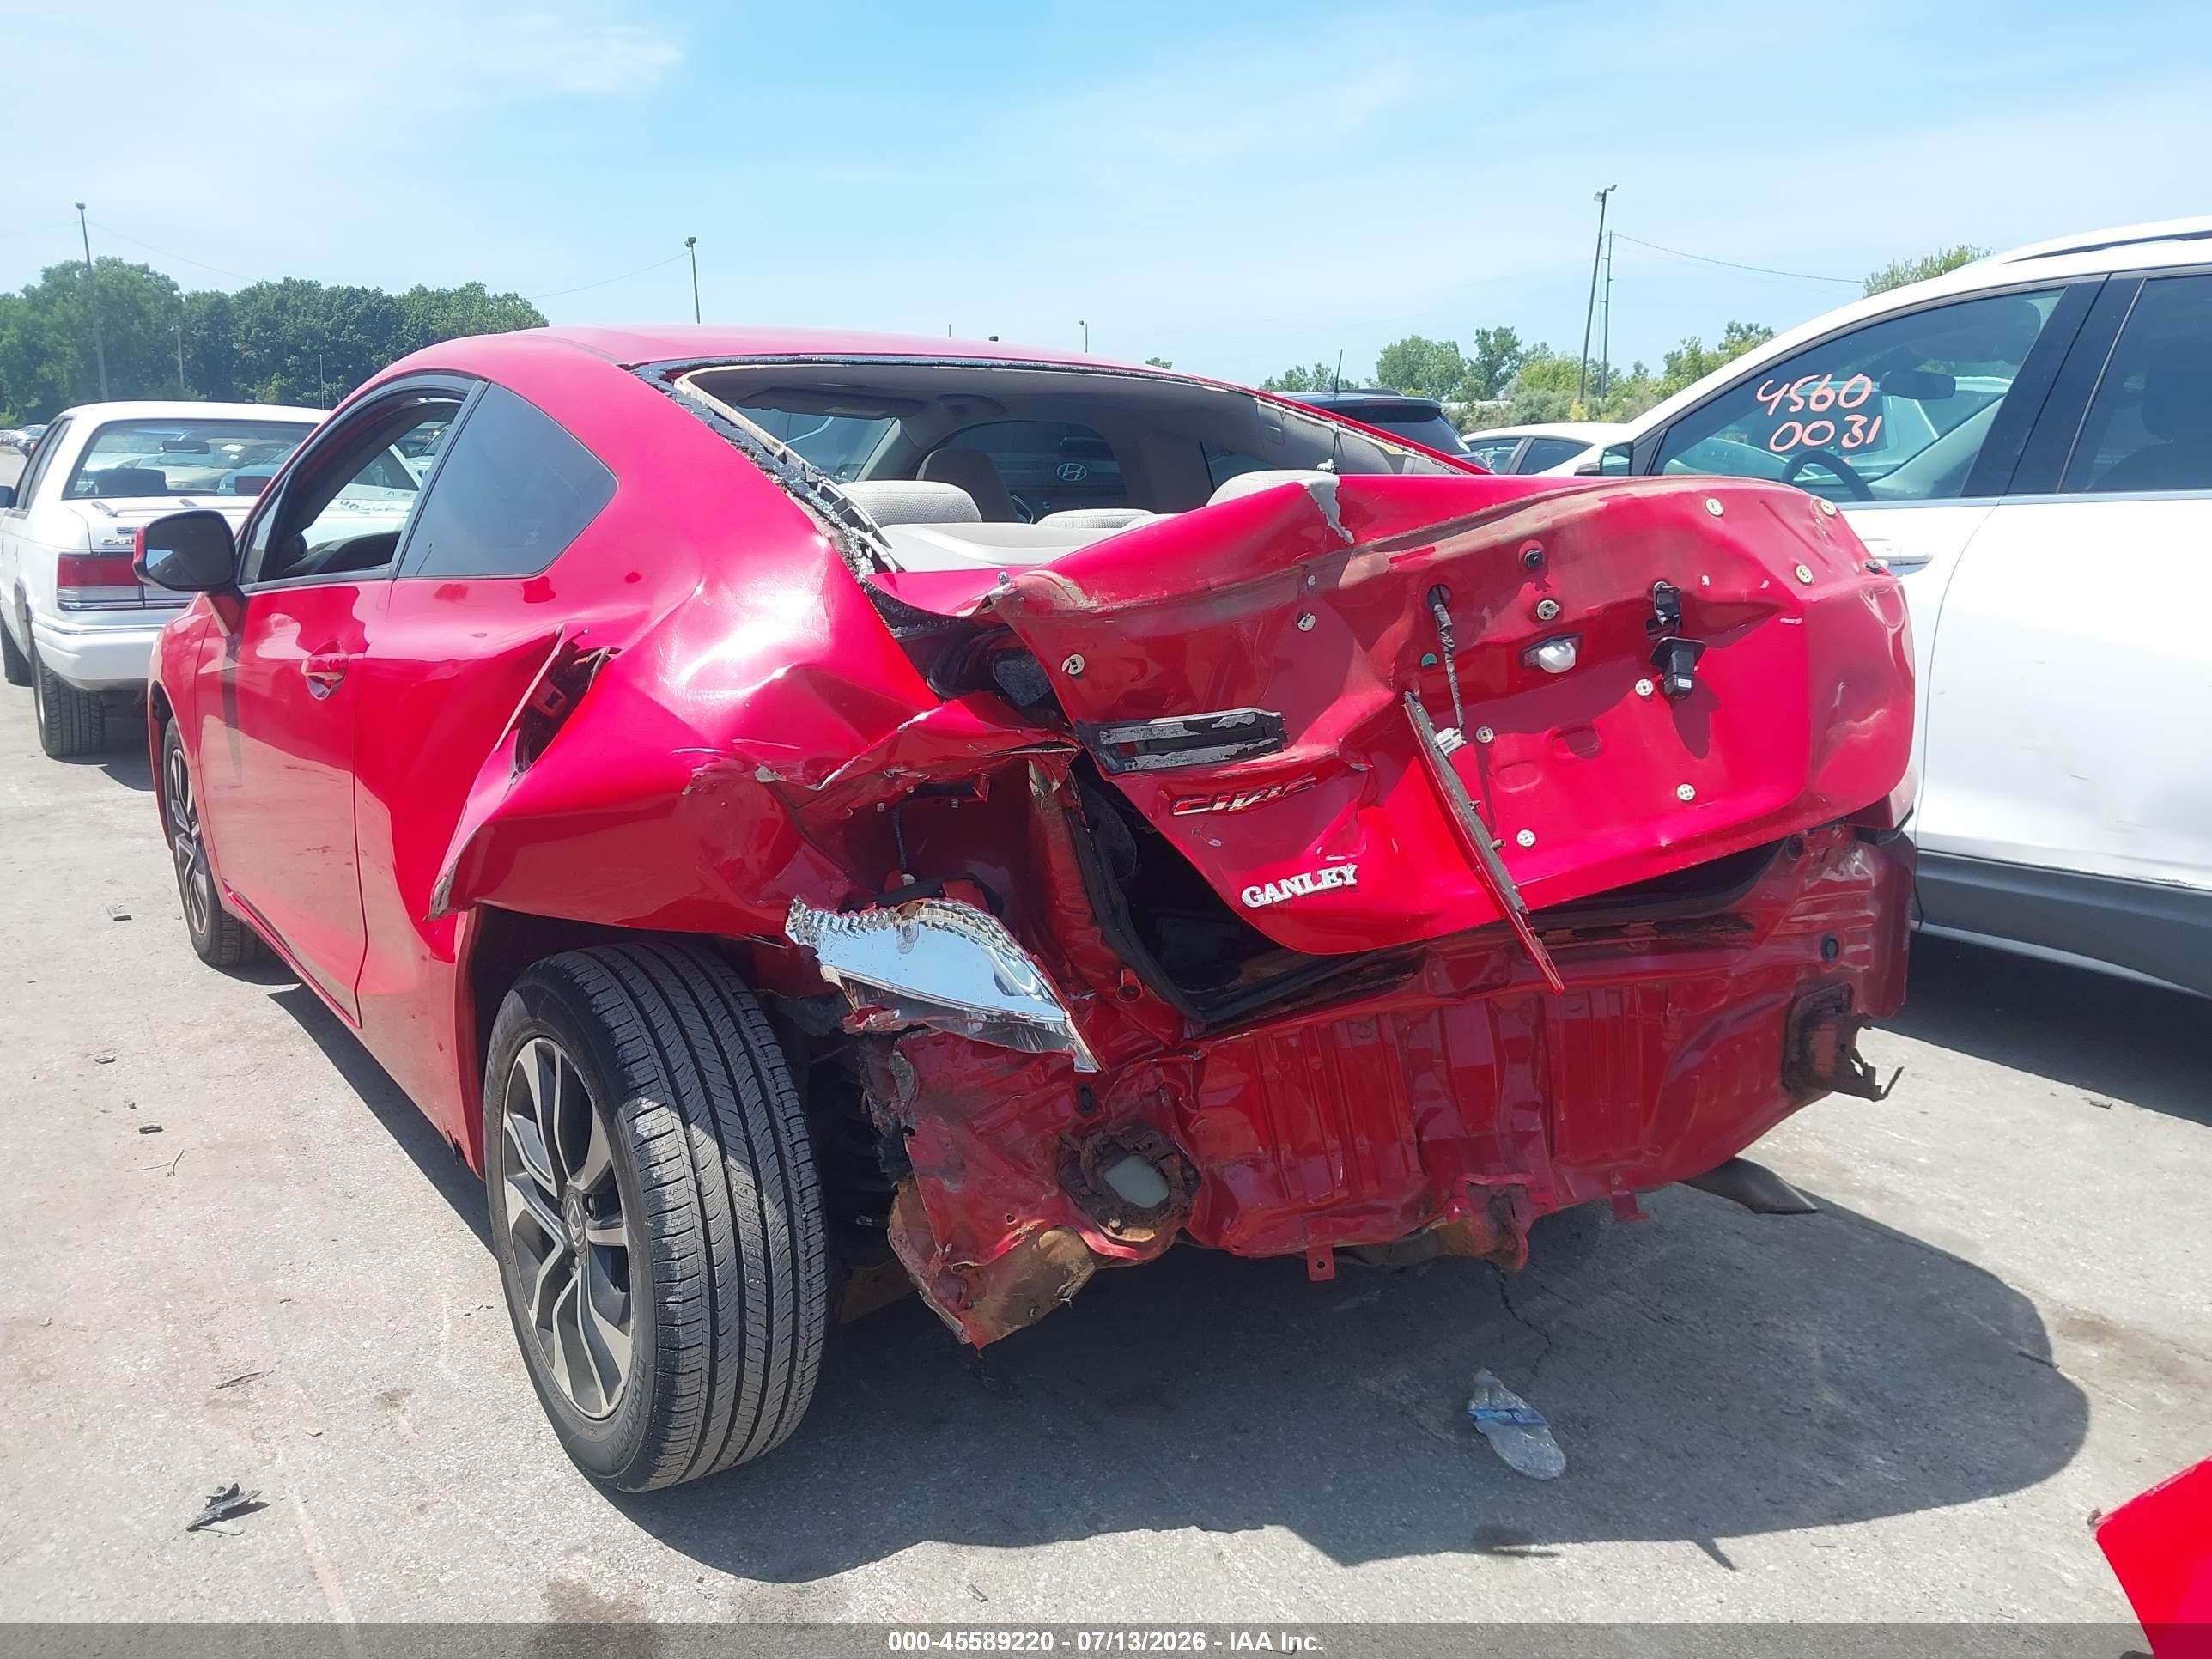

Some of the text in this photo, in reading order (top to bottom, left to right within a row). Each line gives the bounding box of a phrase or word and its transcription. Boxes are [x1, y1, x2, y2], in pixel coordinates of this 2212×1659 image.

[1756, 373, 1873, 416] 4560
[1769, 414, 1883, 453] 0031
[1241, 862, 1358, 908] GANLEY
